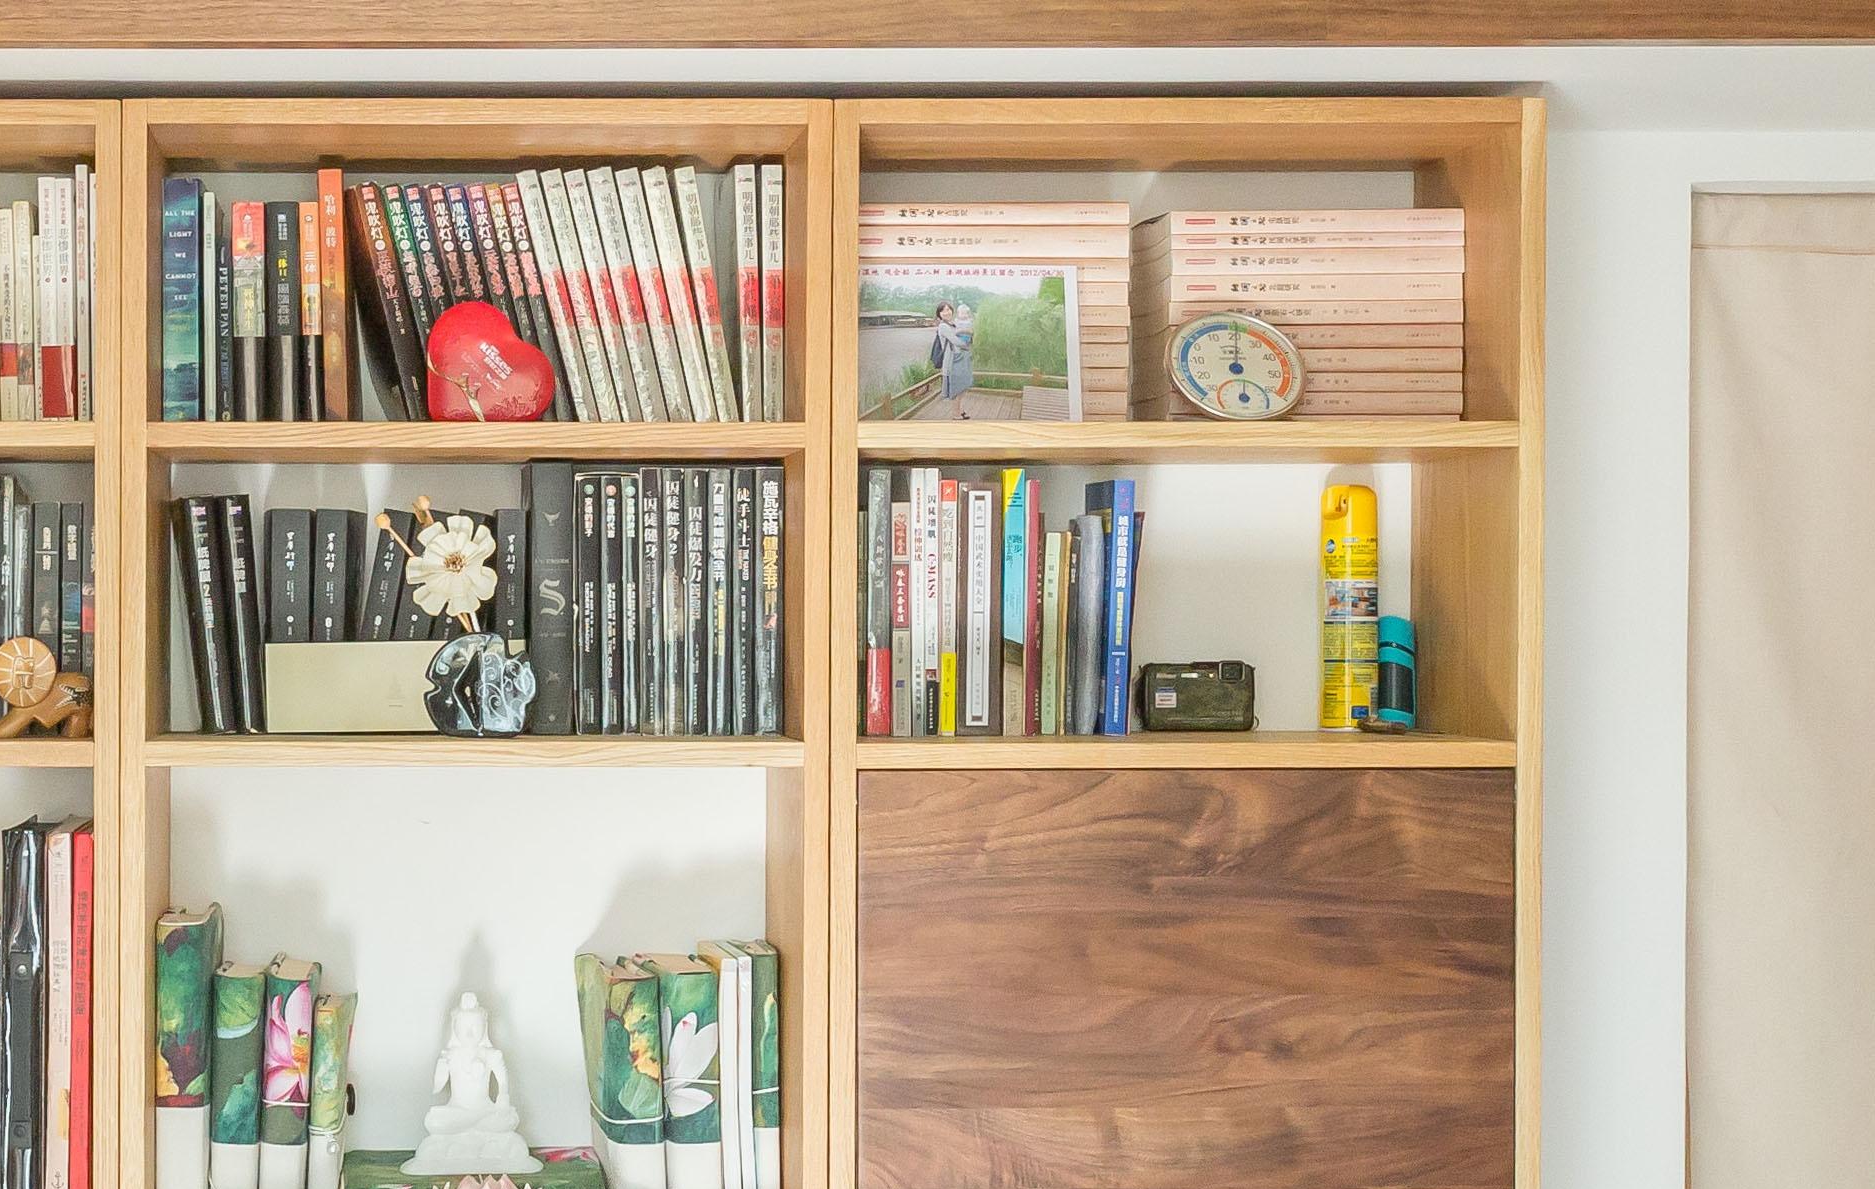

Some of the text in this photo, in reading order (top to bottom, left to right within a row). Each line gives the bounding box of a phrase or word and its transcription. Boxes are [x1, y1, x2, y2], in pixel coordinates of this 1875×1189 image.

[325, 195, 336, 248] 哈利·波特
[742, 191, 755, 261] 明朝那些事儿
[767, 194, 780, 264] 明朝那些事儿
[305, 251, 317, 273] 三体
